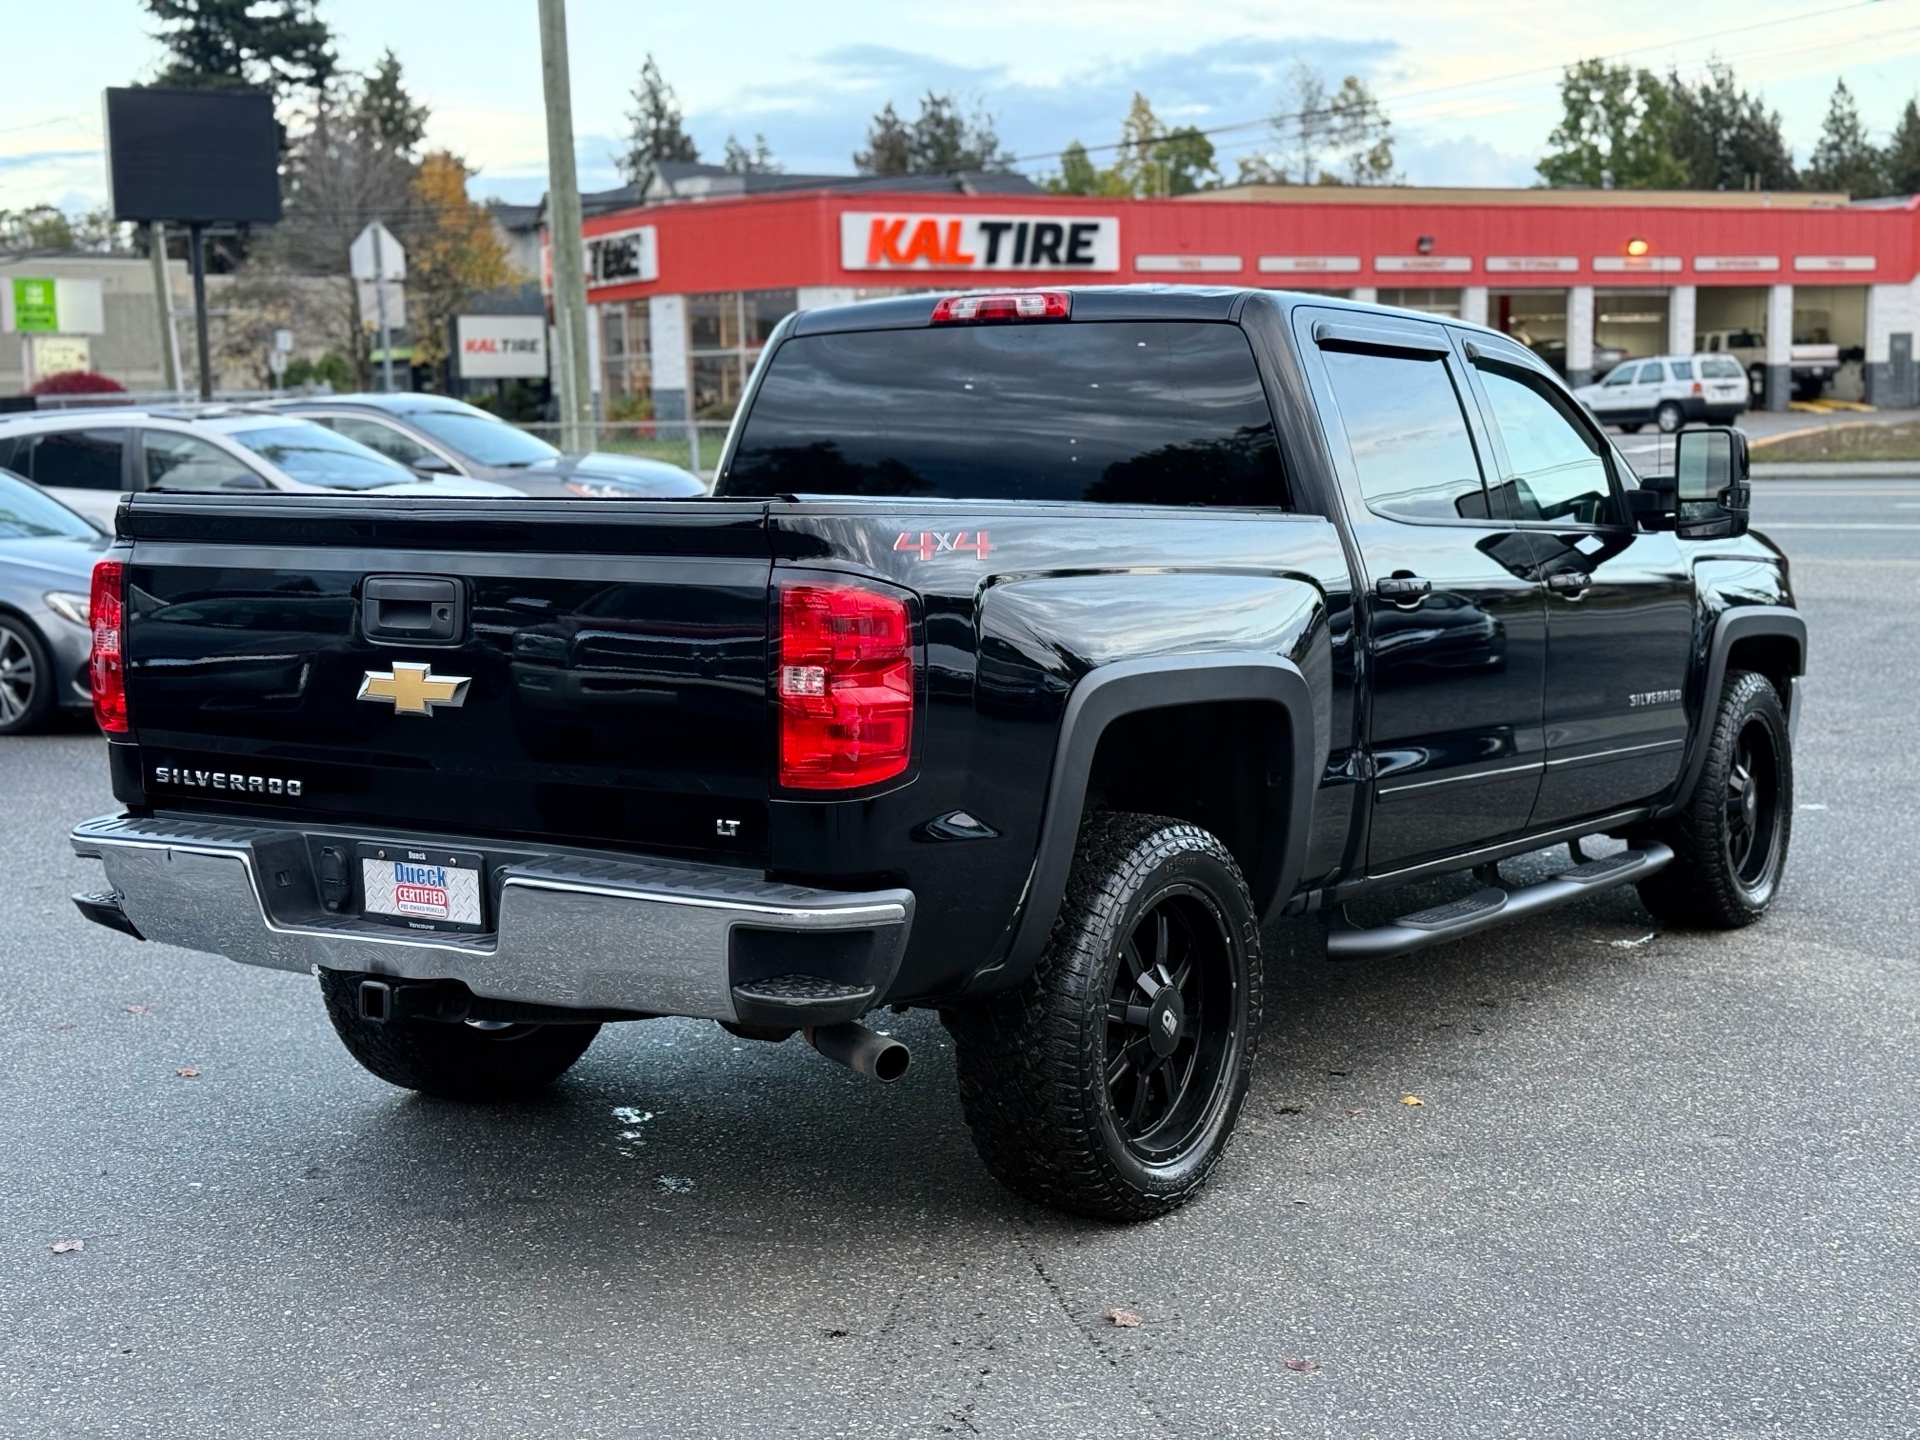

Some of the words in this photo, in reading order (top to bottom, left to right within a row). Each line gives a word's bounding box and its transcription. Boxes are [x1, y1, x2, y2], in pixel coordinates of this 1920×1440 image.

[867, 218, 976, 265] KAL
[978, 221, 1100, 266] TIRE
[465, 337, 498, 353] KAL
[501, 338, 540, 353] TIRE
[1628, 689, 1682, 707] SILVERADO
[155, 767, 301, 796] SILVERADO
[716, 819, 741, 837] LT
[408, 850, 427, 861] Dueck
[393, 861, 448, 888] Dueck
[397, 887, 446, 905] CERTIFIED
[408, 921, 435, 931] Vancouver
